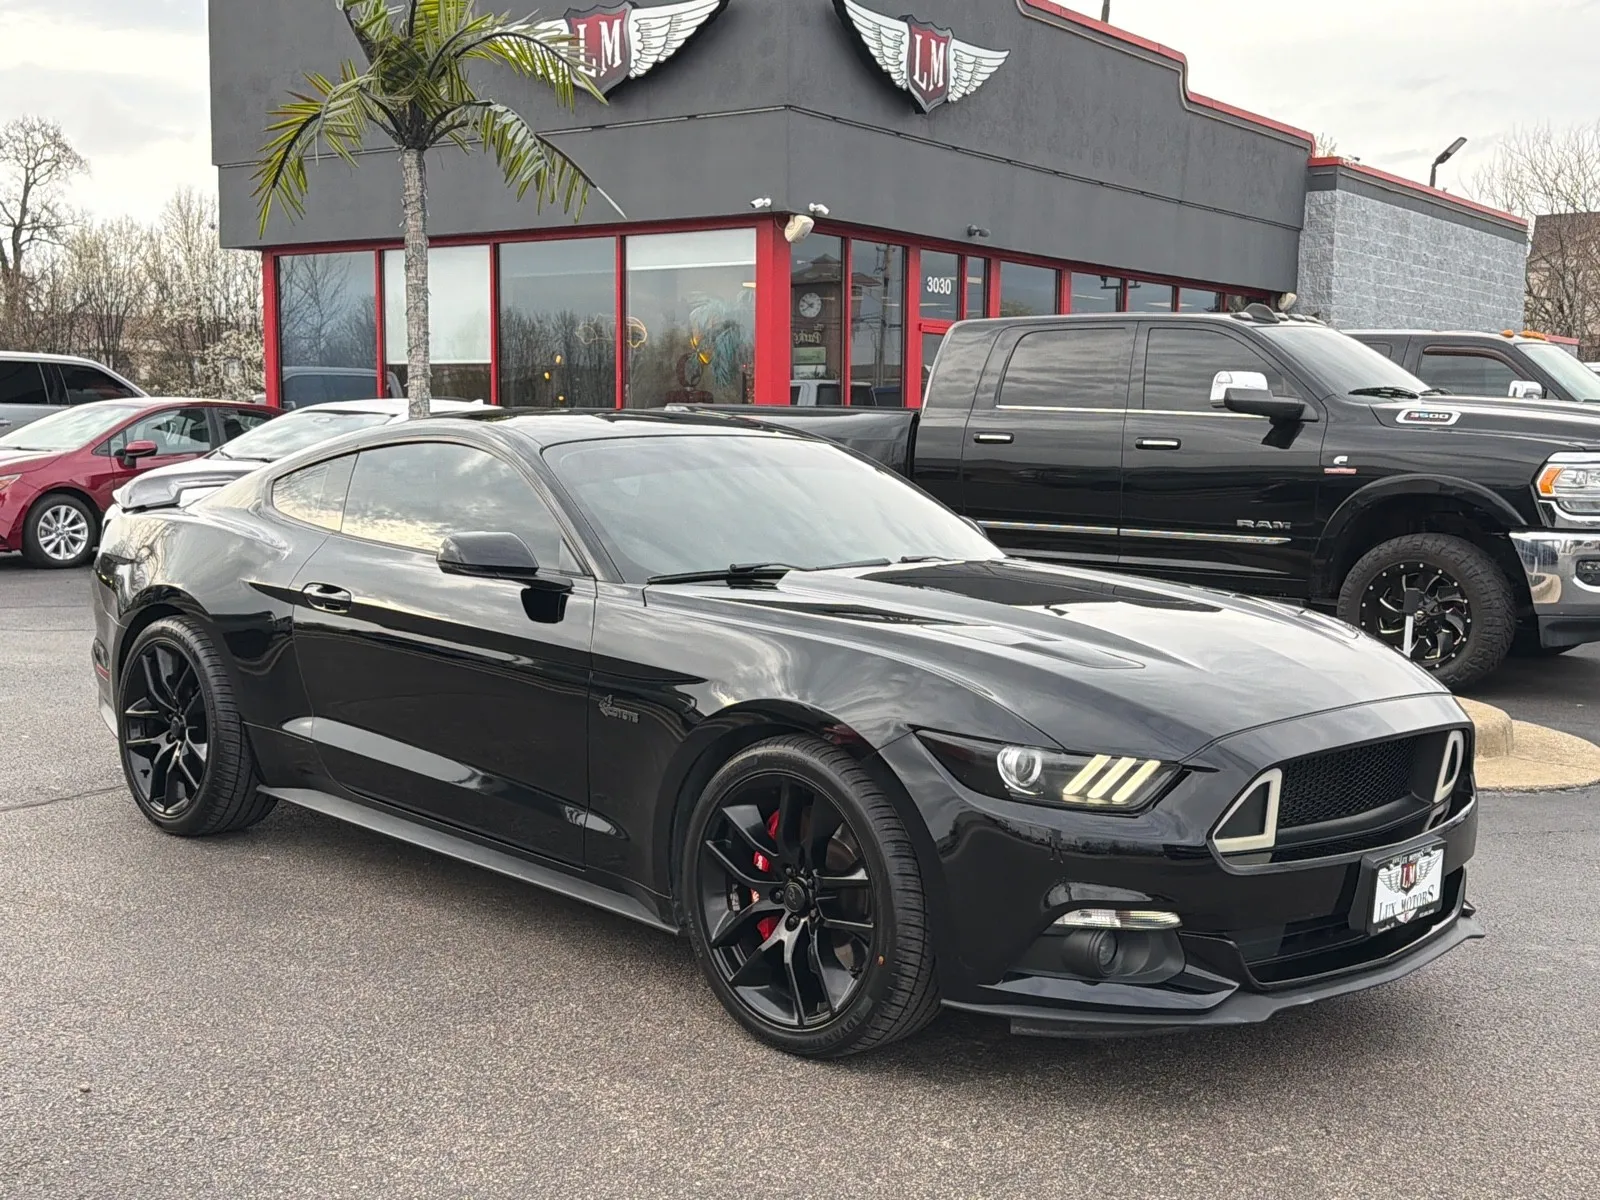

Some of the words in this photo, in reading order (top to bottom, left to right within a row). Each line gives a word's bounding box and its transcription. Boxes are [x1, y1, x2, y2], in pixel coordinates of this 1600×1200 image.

[577, 18, 622, 78] LM
[912, 33, 946, 92] LM
[926, 276, 952, 295] 3030
[1236, 519, 1292, 530] RAM
[1401, 884, 1435, 912] MOTORS
